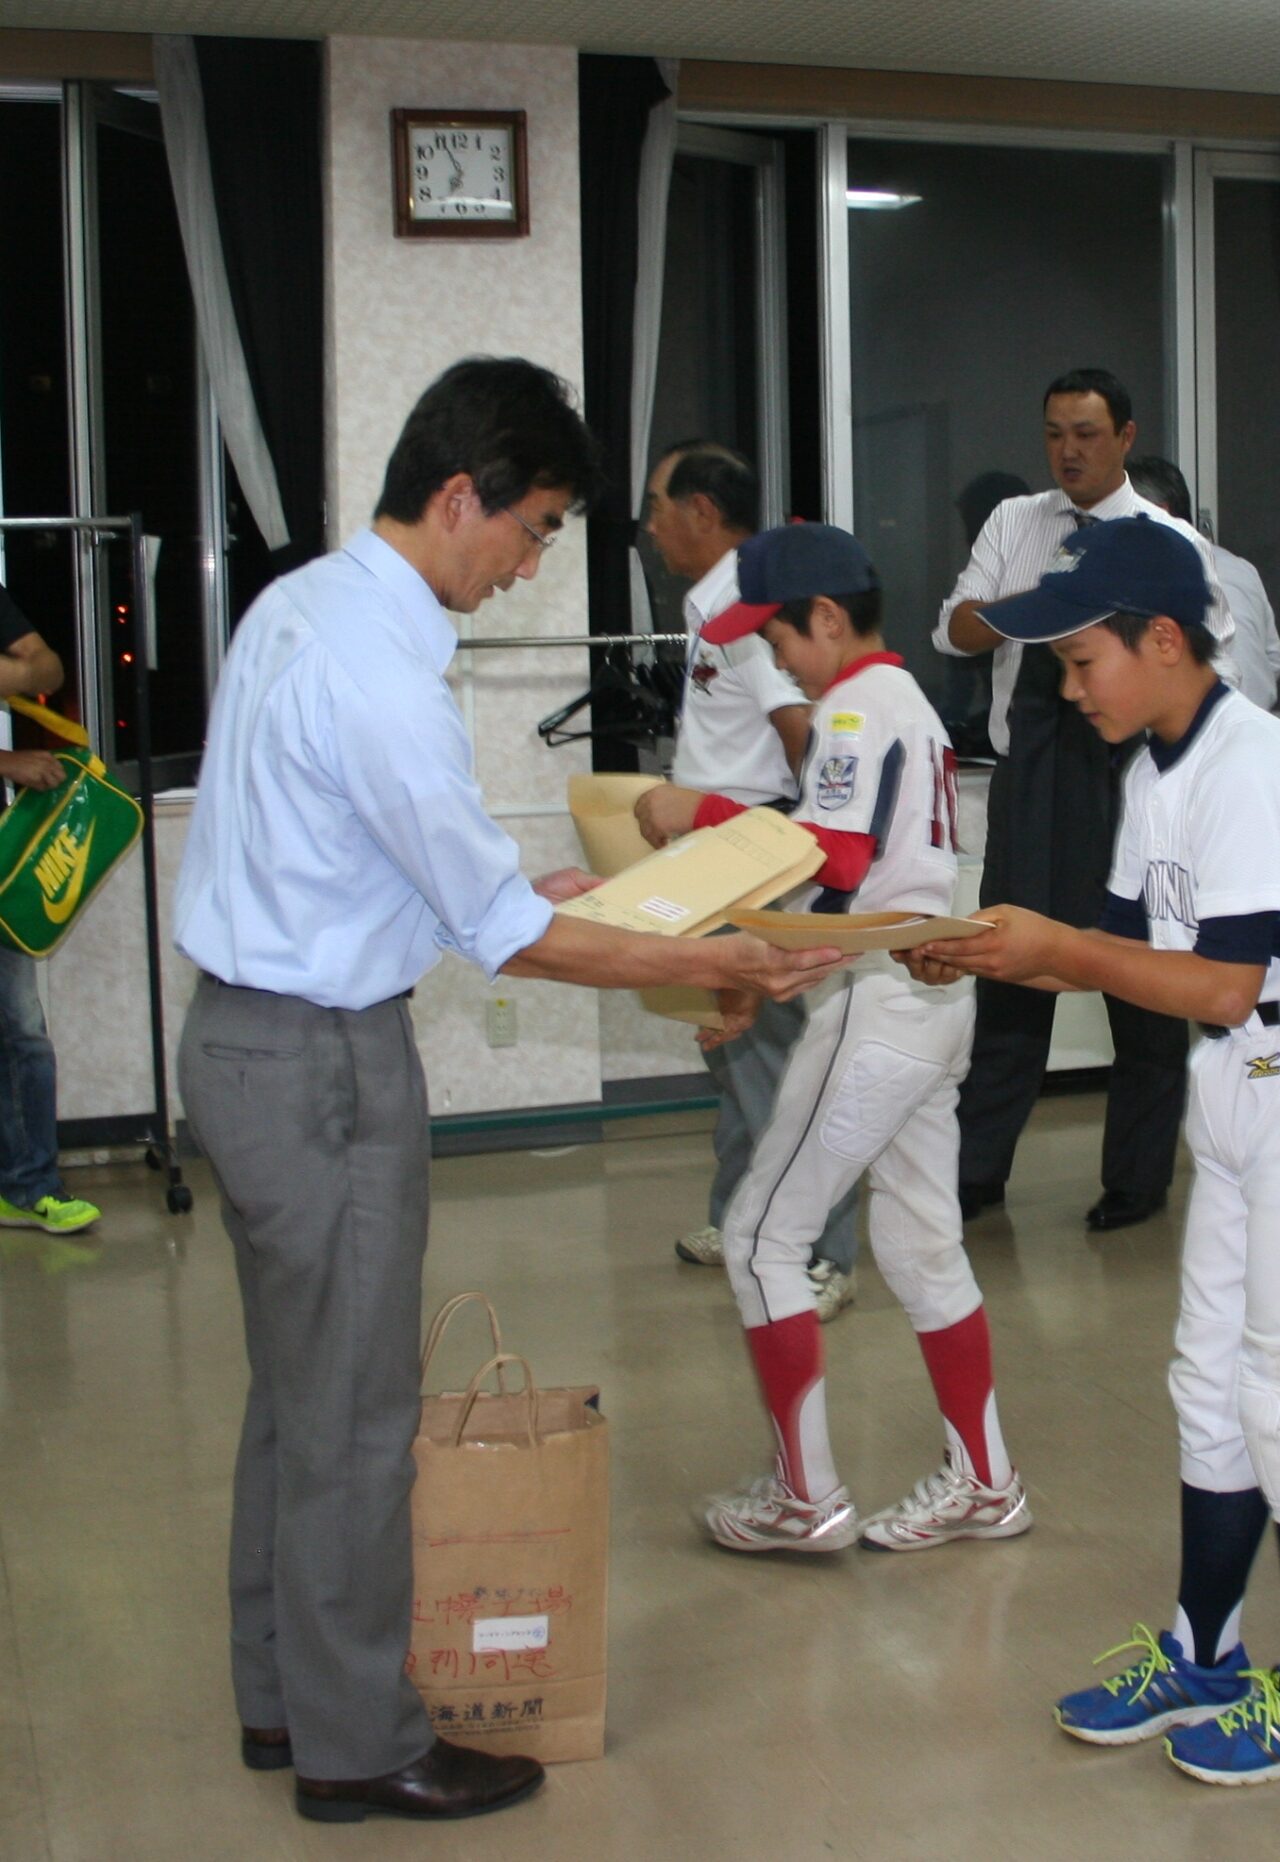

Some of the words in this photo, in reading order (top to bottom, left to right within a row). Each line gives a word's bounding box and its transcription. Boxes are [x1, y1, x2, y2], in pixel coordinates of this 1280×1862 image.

[451, 132, 468, 149] 12
[416, 144, 434, 160] 10
[416, 164, 429, 181] 9
[493, 166, 504, 182] 3
[419, 185, 432, 202] 8
